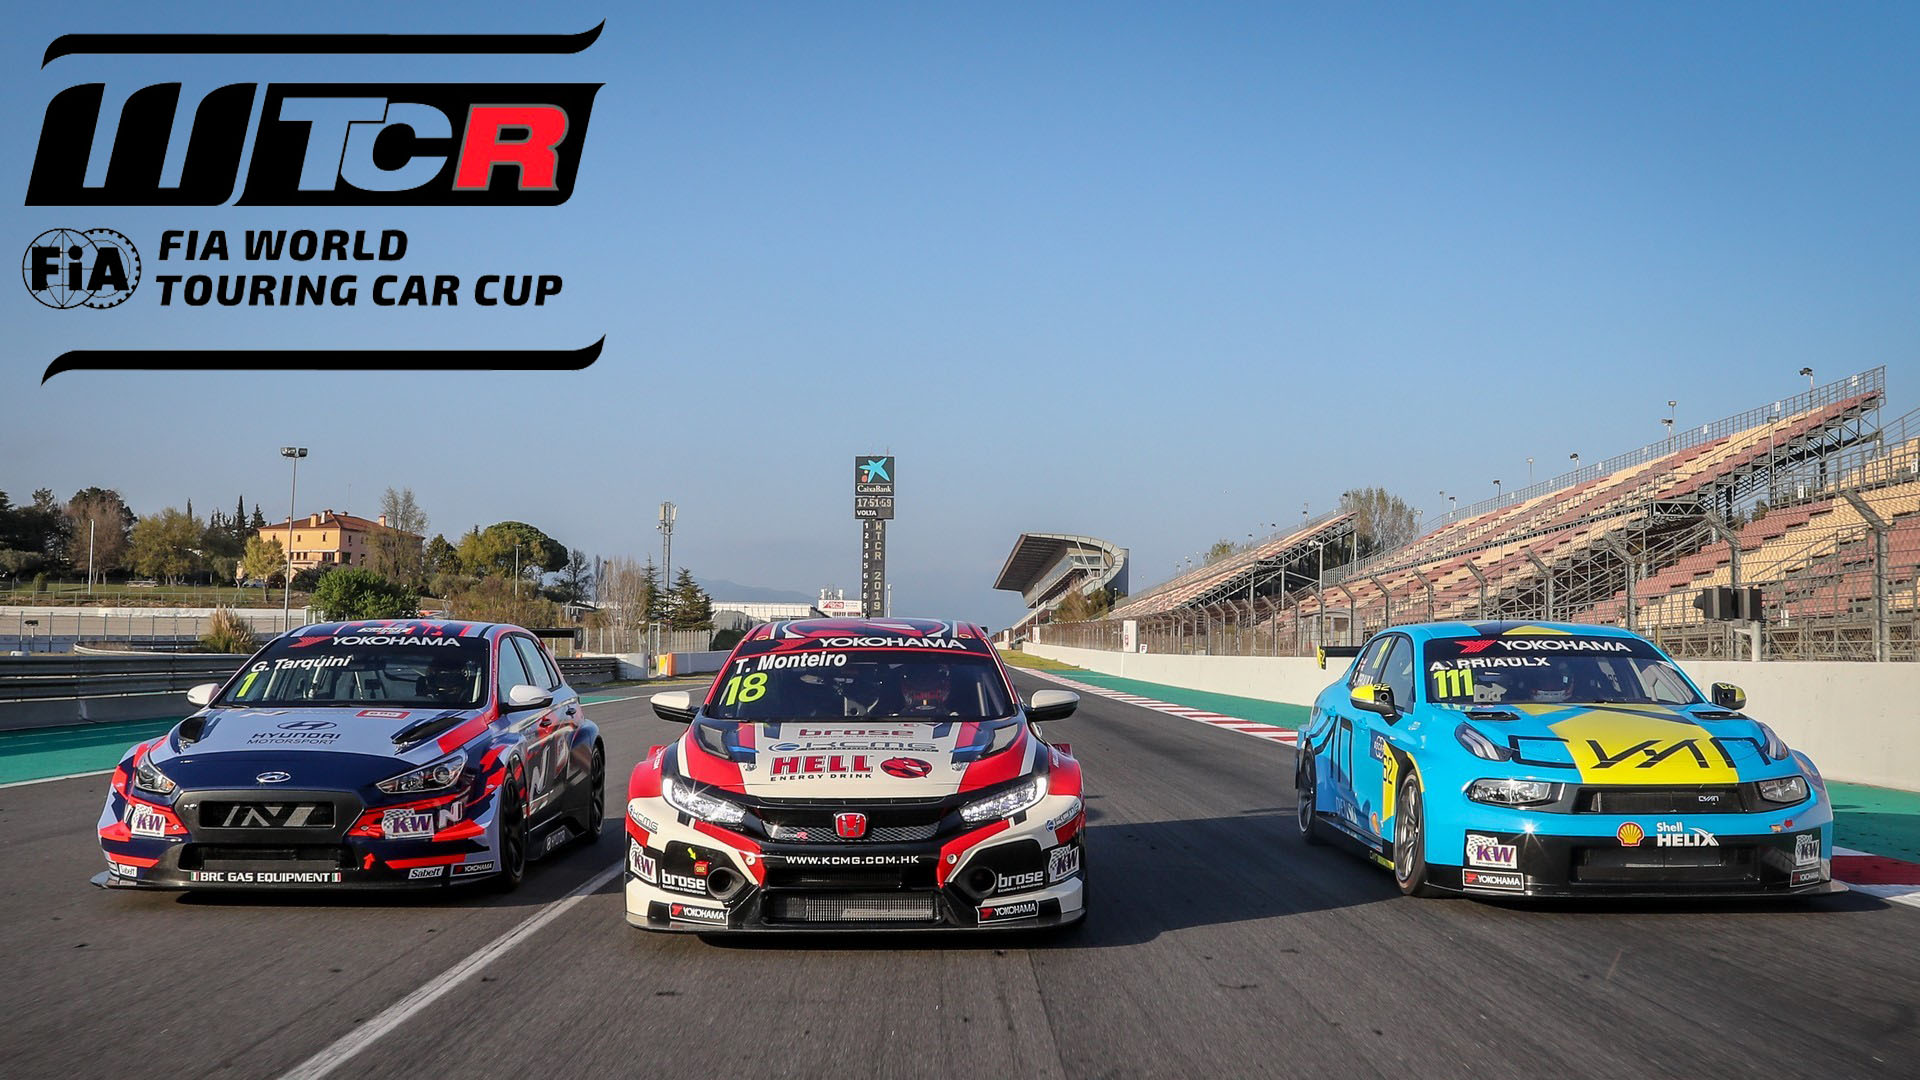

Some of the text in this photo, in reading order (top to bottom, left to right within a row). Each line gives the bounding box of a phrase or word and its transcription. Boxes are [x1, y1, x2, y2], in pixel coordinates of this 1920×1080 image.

[332, 635, 461, 647] YOKOHAMA
[819, 636, 967, 650] YOKOHAMA
[1497, 640, 1632, 652] YOKOHAMA
[251, 655, 354, 672] G. Tarquini
[735, 651, 847, 674] T. Monteiro
[1457, 657, 1550, 669] PRIAULX
[236, 672, 259, 698] 1
[726, 672, 768, 706] 18
[1433, 668, 1474, 699] 111
[799, 728, 914, 736] brose
[770, 755, 874, 776] HELL
[136, 813, 164, 831] KW
[393, 815, 433, 833] KW
[1656, 821, 1683, 832] Shell
[1656, 828, 1719, 847] HELIX
[1477, 844, 1514, 863] KW
[1801, 842, 1818, 860] KW
[634, 850, 654, 877] KW
[785, 855, 920, 865] WWW.KCMG.COM.HK
[1056, 848, 1078, 875] KW
[200, 872, 330, 883] BRC GAS EQUIPMENT
[661, 868, 706, 890] brose
[998, 871, 1043, 888] brose
[1477, 875, 1520, 886] YOKOHAMA
[683, 906, 725, 920] YOKOHAMA
[994, 903, 1036, 916] YOKOHAMA
